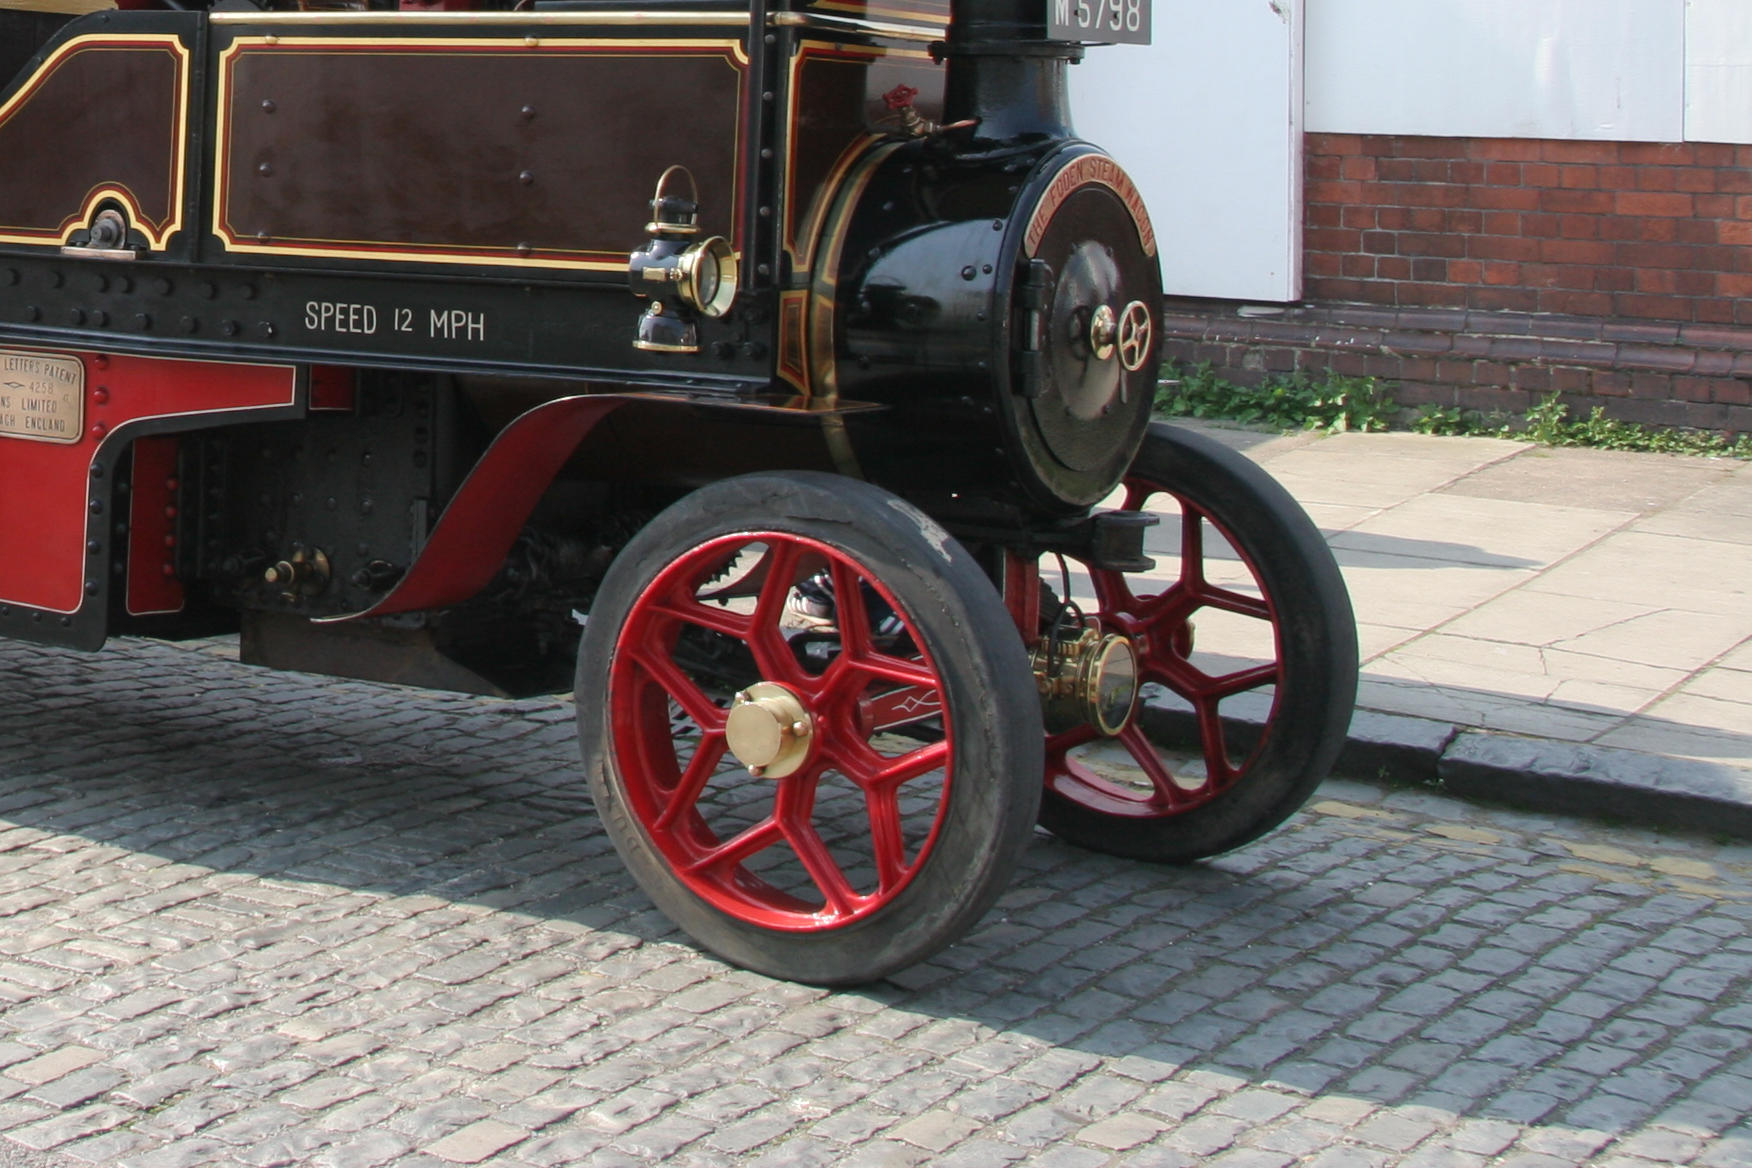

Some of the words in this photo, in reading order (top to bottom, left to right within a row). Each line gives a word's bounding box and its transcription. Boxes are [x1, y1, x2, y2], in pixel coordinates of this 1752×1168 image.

[1028, 206, 1048, 246] THE
[1049, 161, 1084, 206] FODEN
[1089, 158, 1124, 192] STEAM
[305, 301, 377, 334] SPEED
[394, 308, 413, 331] 12
[430, 309, 484, 341] MPH
[4, 358, 40, 374] LETTERS
[44, 364, 77, 385] PATENT
[21, 398, 57, 413] LIMITED
[25, 416, 66, 432] ENGLAND
